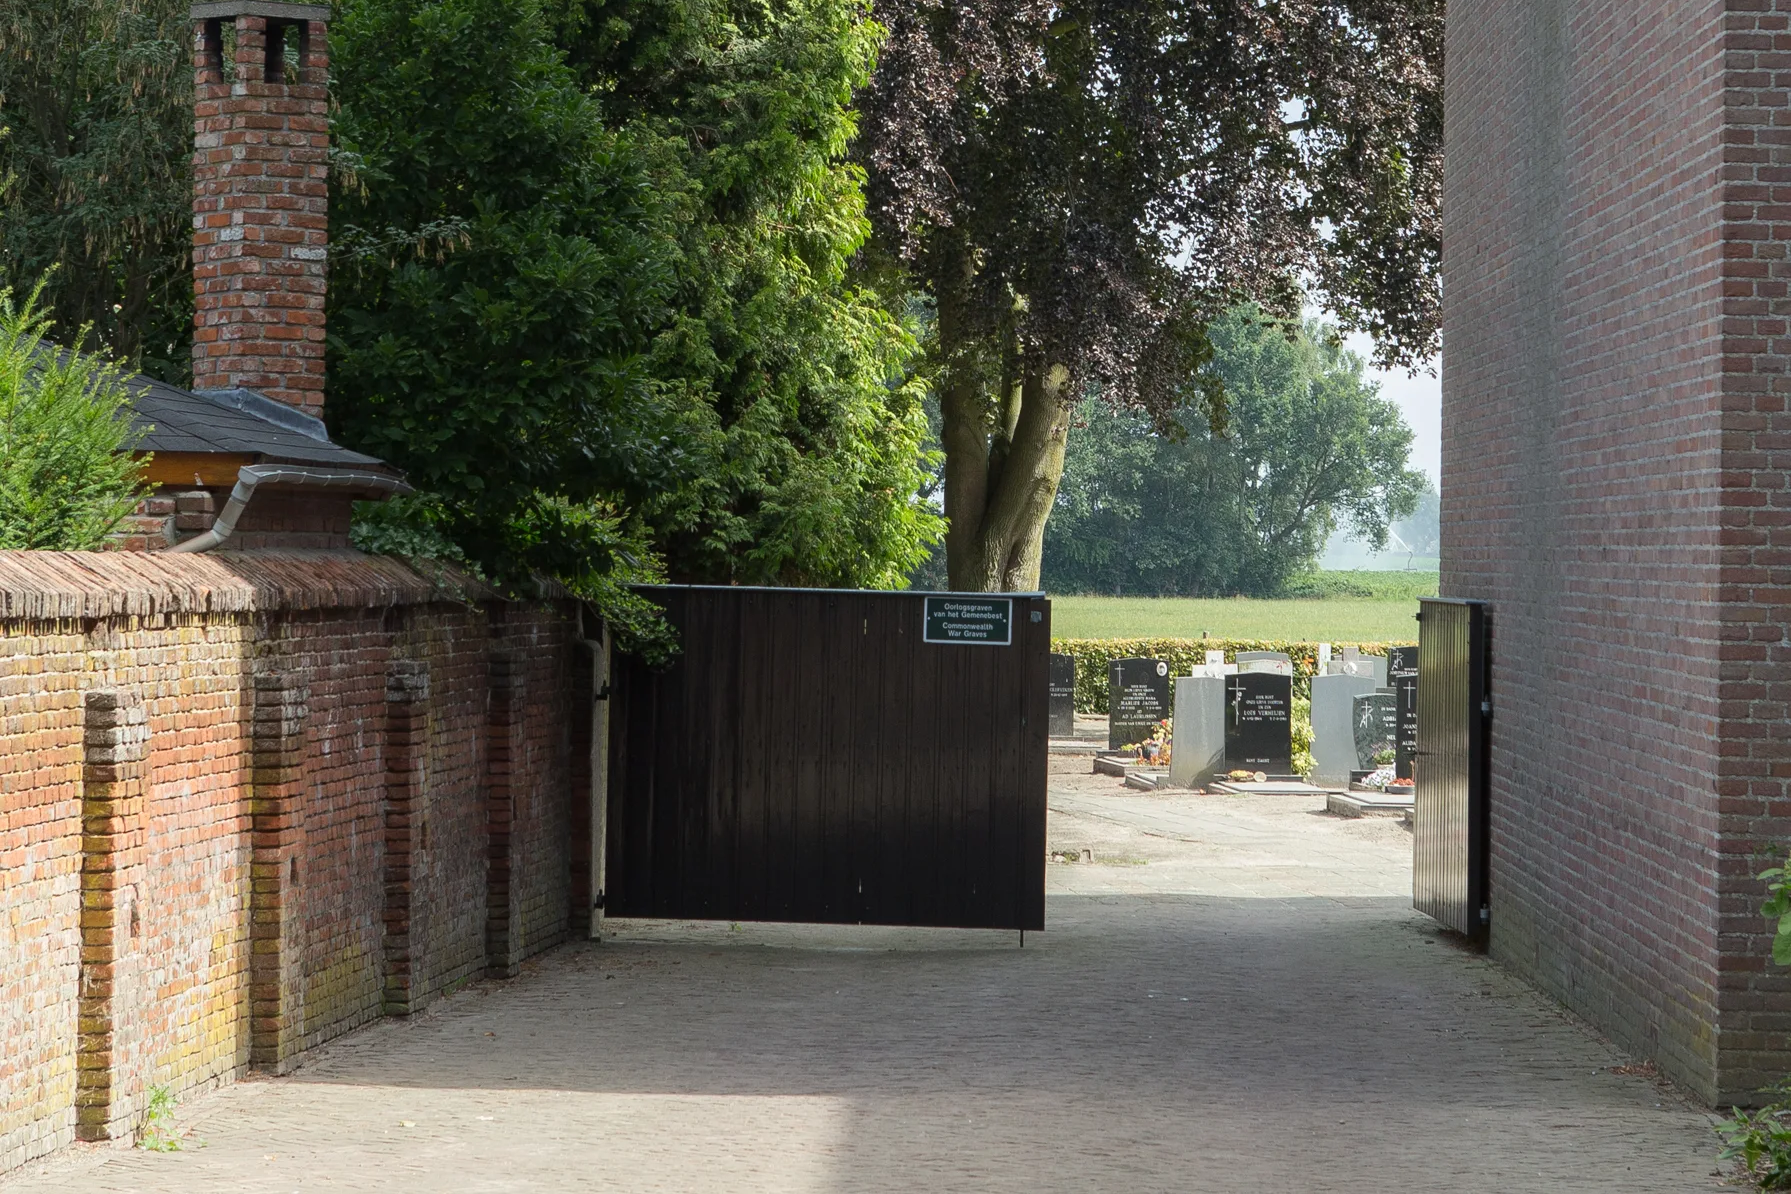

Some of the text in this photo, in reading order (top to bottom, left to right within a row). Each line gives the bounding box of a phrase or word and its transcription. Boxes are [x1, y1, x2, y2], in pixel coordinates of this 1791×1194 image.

[944, 603, 992, 611] Oorlogsgraven
[961, 611, 1003, 619] Gemenebest
[942, 622, 993, 630] Commonwealth
[963, 630, 987, 638] Graves
